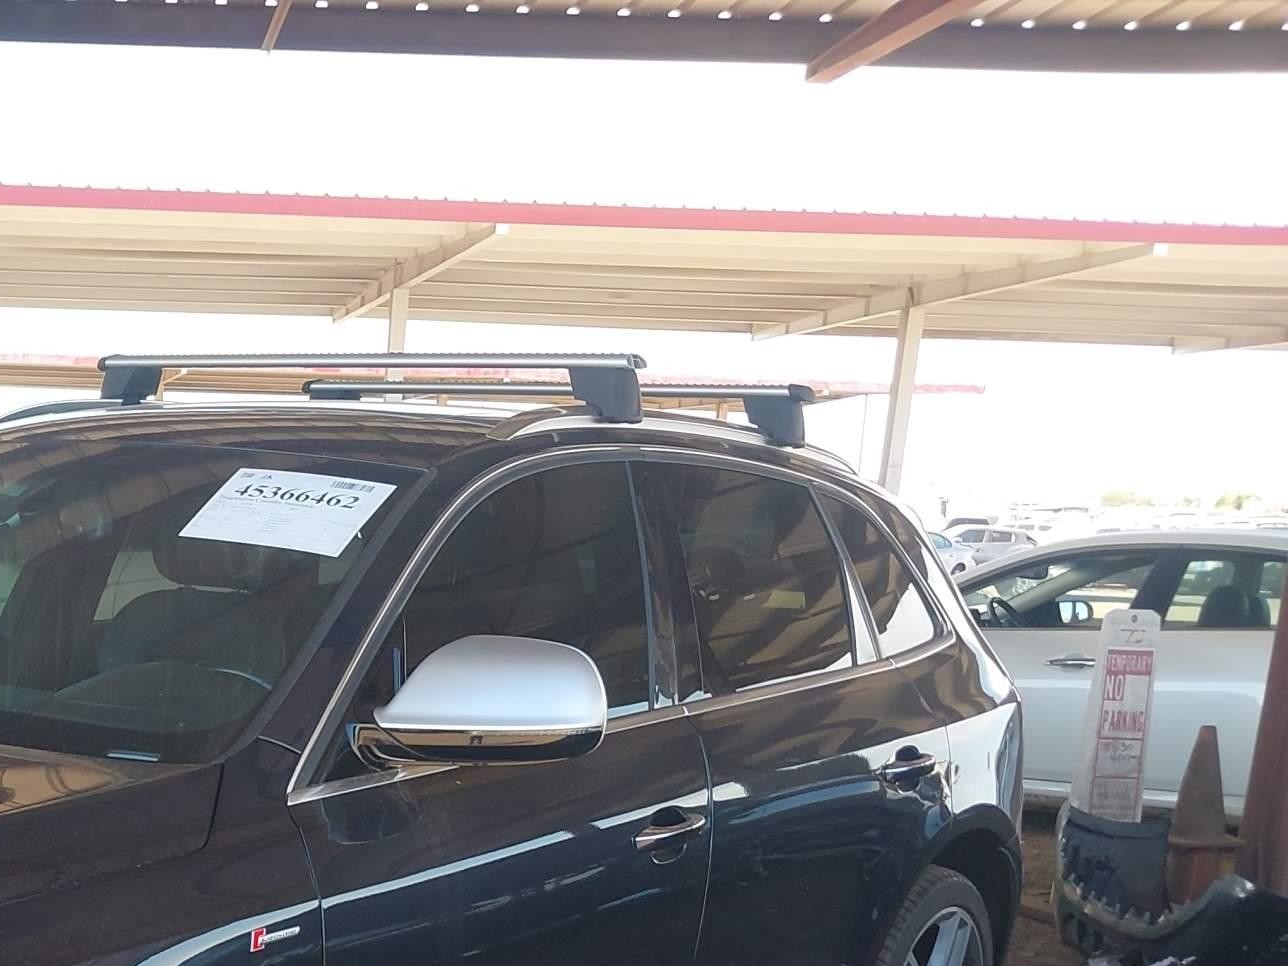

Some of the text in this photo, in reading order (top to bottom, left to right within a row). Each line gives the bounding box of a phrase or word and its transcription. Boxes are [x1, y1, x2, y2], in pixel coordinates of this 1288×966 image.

[233, 482, 360, 509] 45366462
[1107, 654, 1153, 673] TEMPORARY
[1104, 675, 1124, 700] NO
[1102, 710, 1145, 733] PARKING
